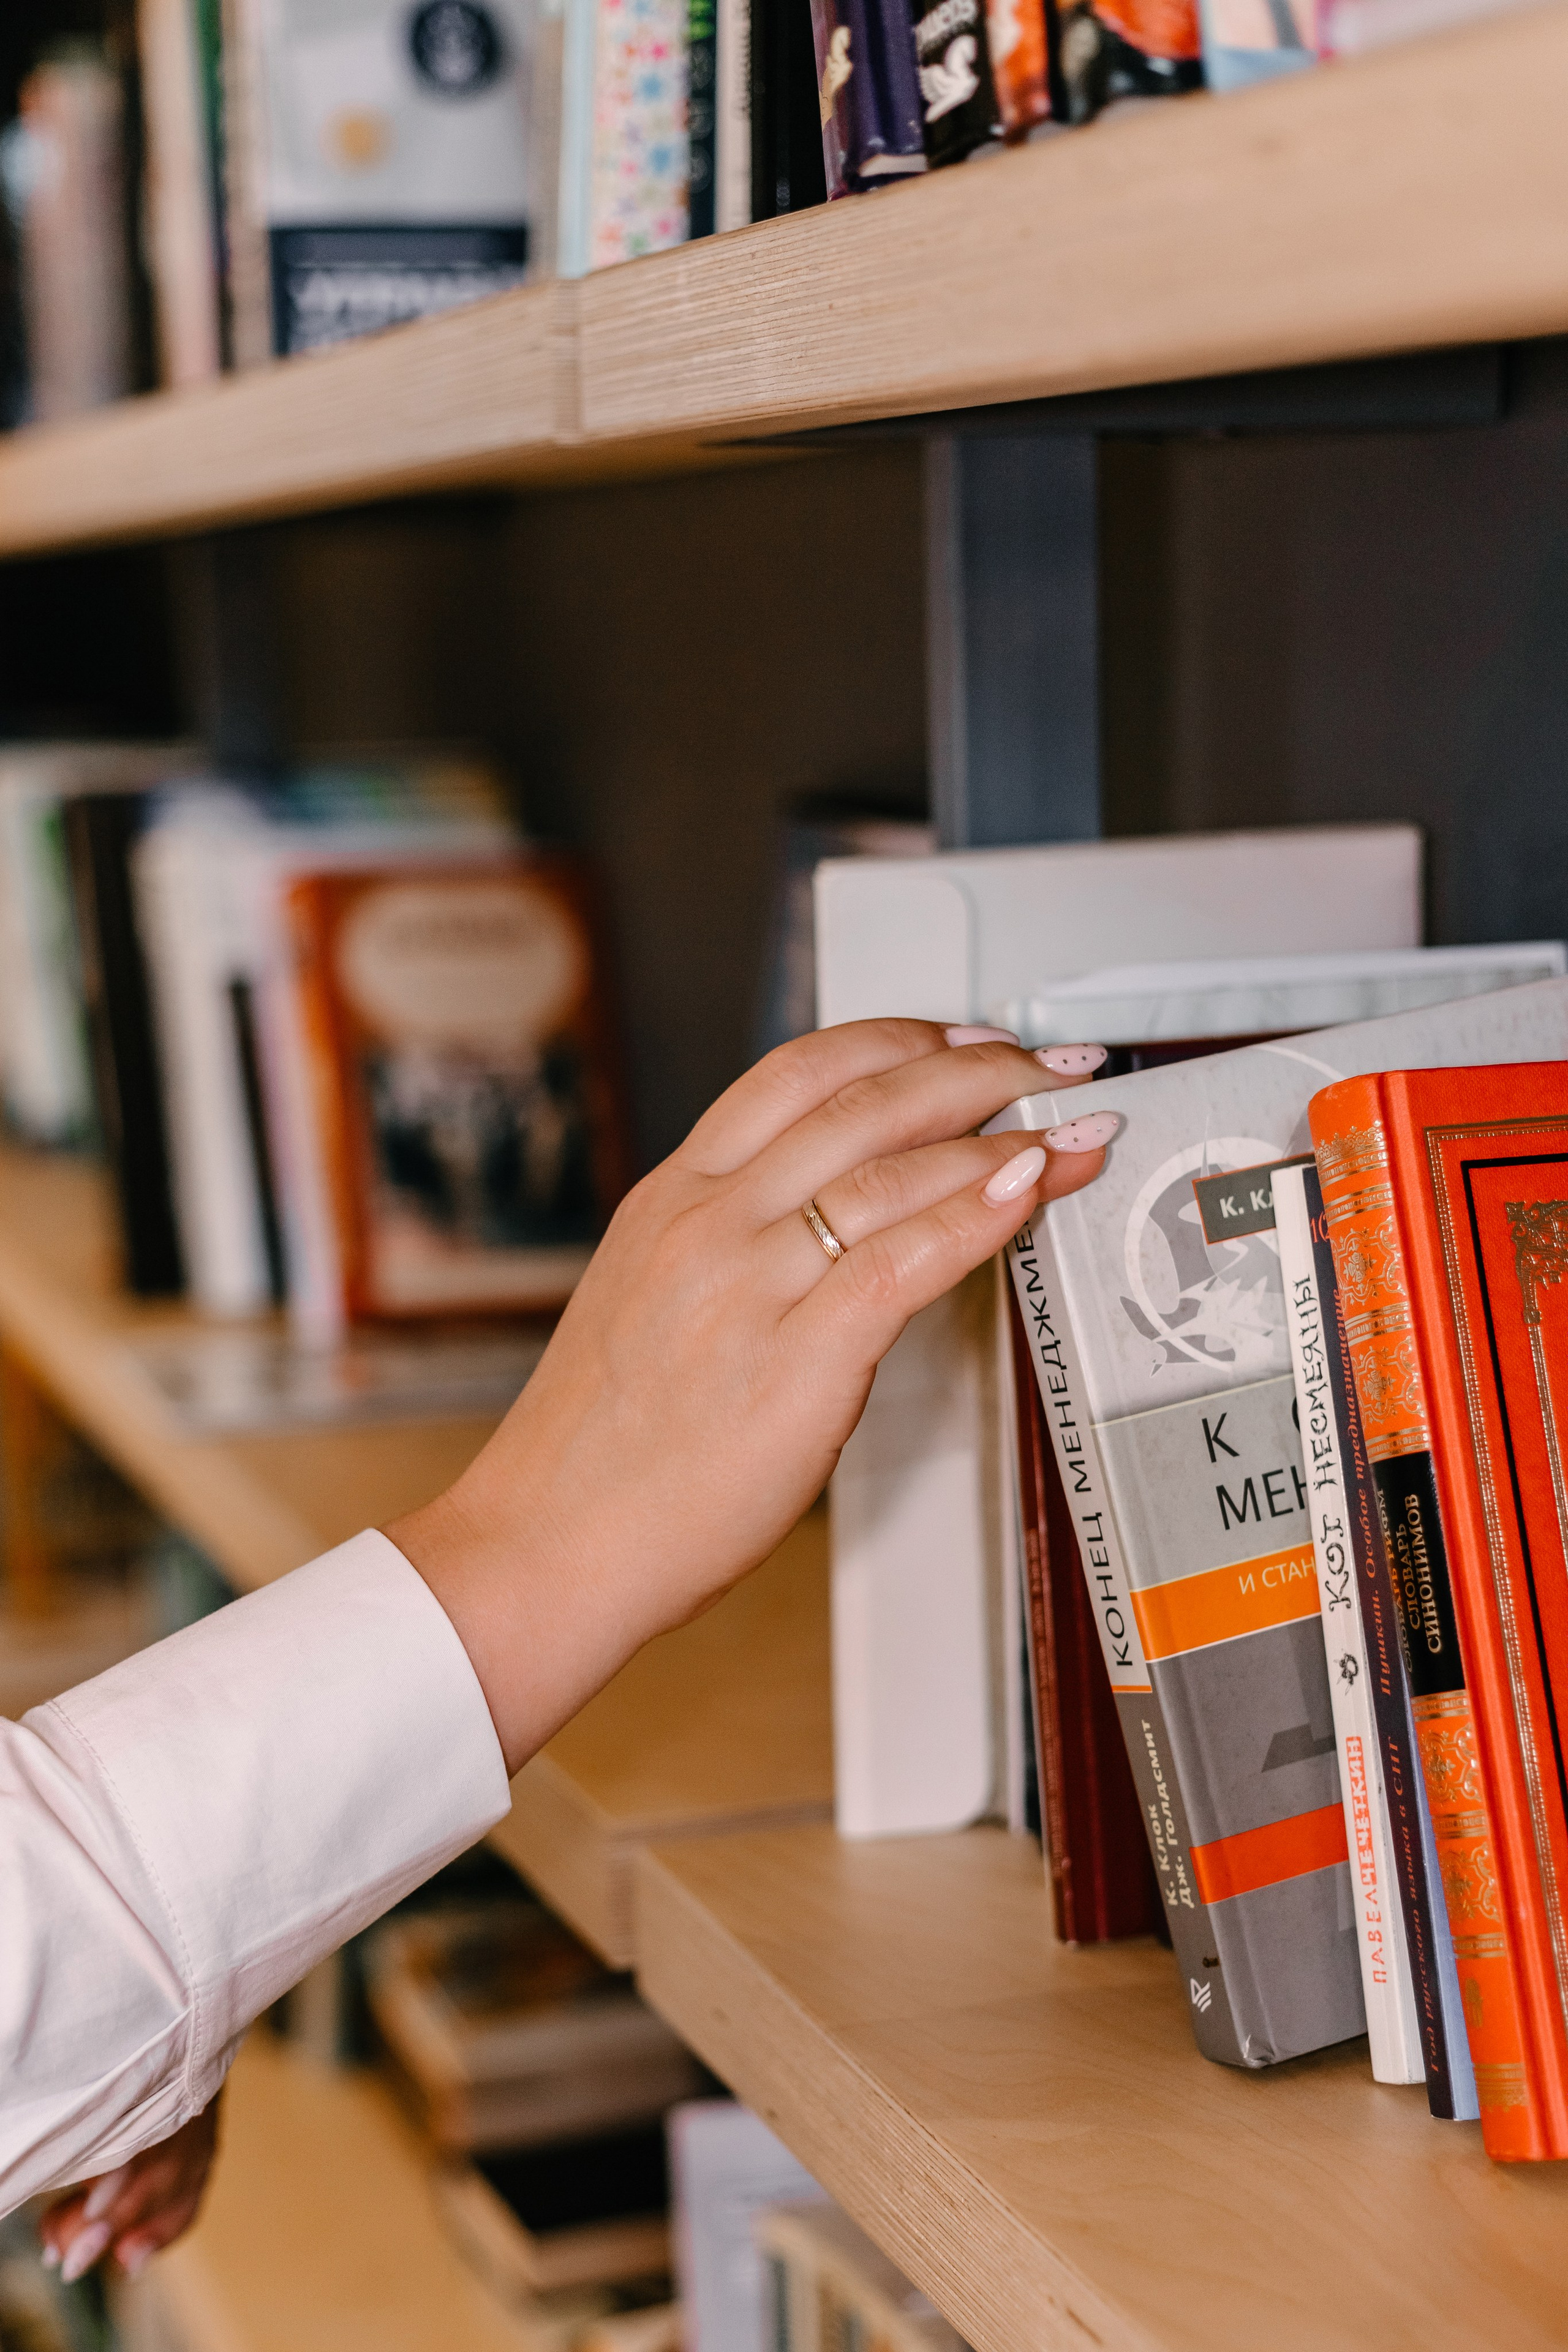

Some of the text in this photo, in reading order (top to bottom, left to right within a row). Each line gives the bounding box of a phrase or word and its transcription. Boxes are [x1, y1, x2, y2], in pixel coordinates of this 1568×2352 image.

[1219, 1188, 1274, 1218] К. К
[1014, 1221, 1092, 1493] МЕНЕДЖМЕ
[1292, 1273, 1352, 1612] КОТ НЕСМЕЯНЫ
[1333, 1289, 1392, 1695] Пушкин. Особое предназначение
[1082, 1512, 1133, 1667] КОНЕЦ
[1238, 1572, 1256, 1595] И
[1378, 1488, 1413, 1673] СЛОВАРЬ РИФМ
[1396, 1523, 1421, 1630] СЛОВАРЬ
[1404, 1493, 1441, 1654] СИНОНИМОВ
[1141, 1719, 1195, 1909] Дж. Голдсмит
[1166, 1880, 1178, 1905] К.
[1365, 1888, 1387, 1984] ПАВЕЛ
[1387, 1735, 1439, 2073] Год русского языка в СНГ
